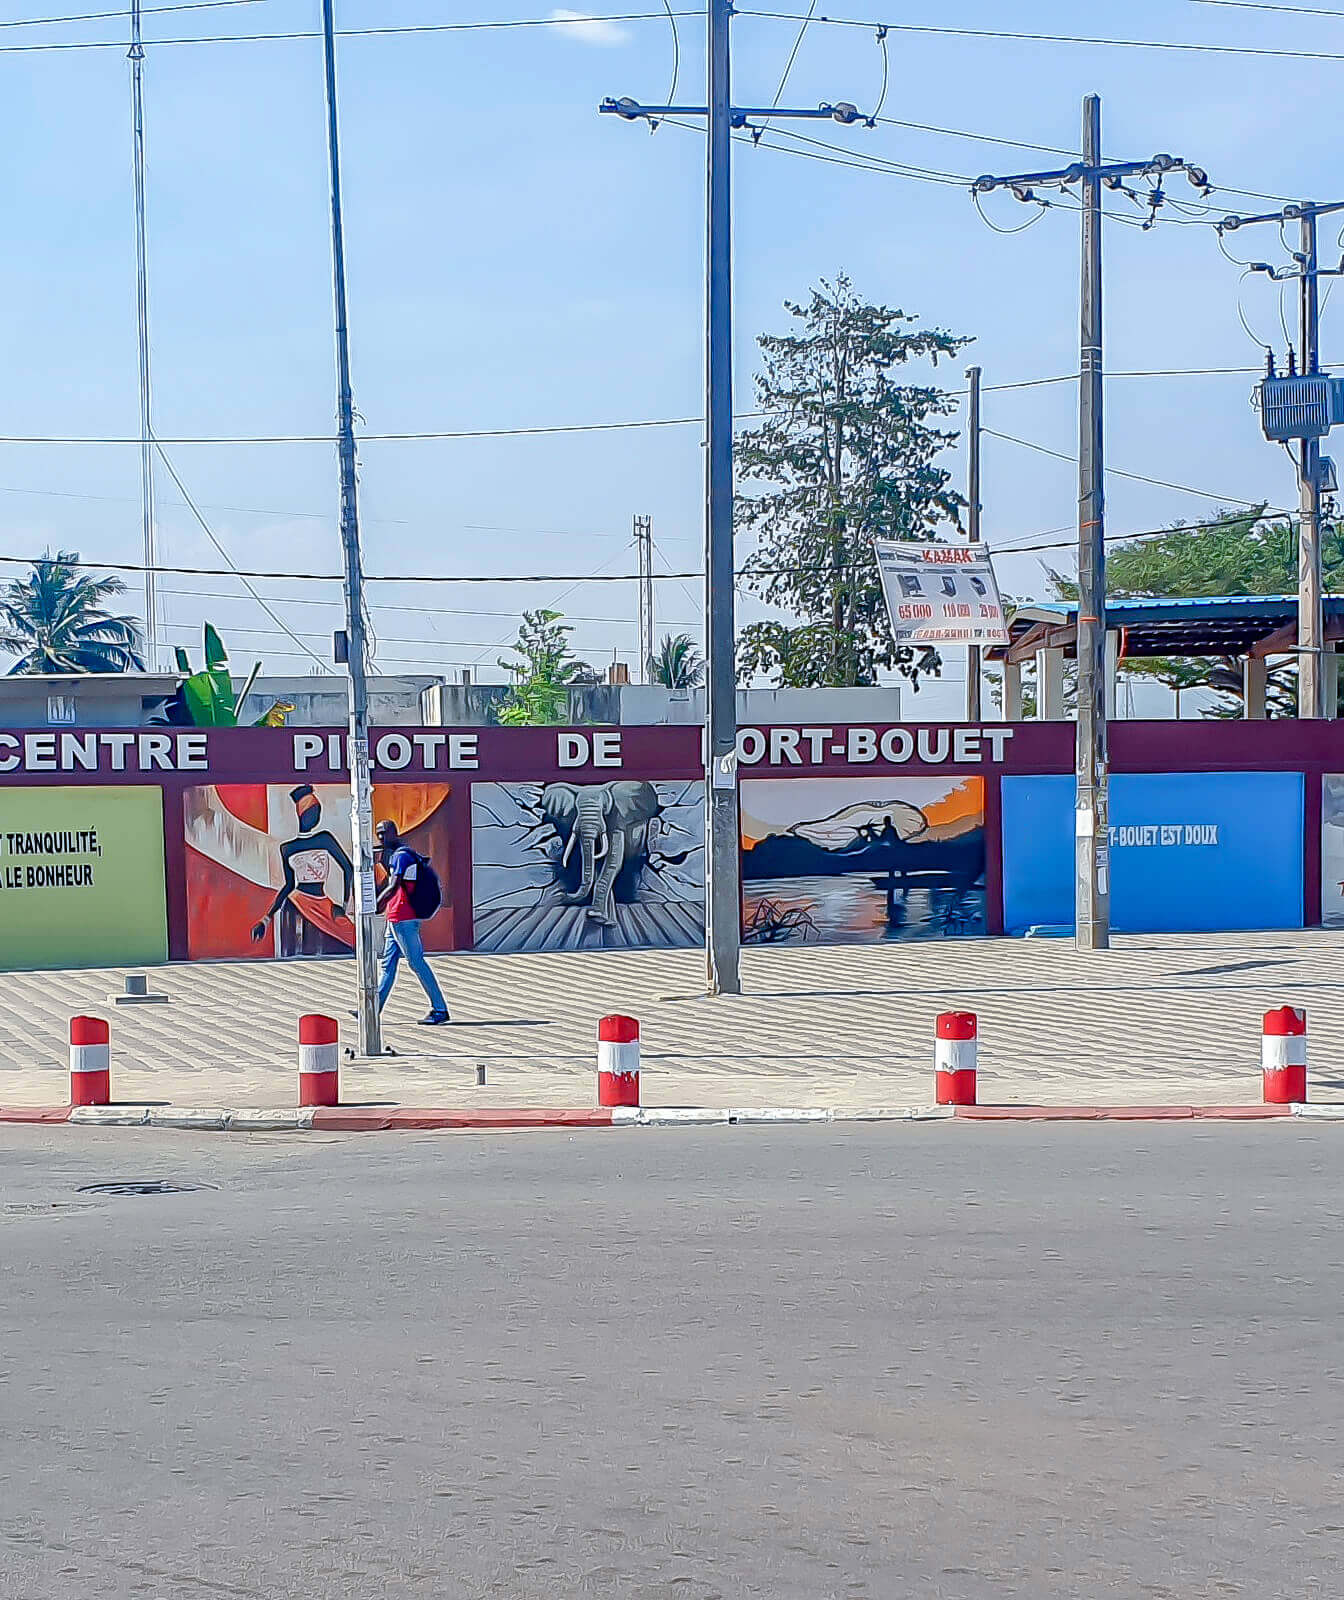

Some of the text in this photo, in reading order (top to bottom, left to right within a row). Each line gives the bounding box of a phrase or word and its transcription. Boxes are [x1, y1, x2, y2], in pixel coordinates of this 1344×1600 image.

[557, 732, 622, 768] DE
[702, 728, 1014, 766] ORT-BOUET
[6, 825, 102, 857] TRANQUILITÉ,
[1160, 825, 1183, 846] EST
[1184, 824, 1218, 845] DOUX
[6, 866, 23, 888] LE
[26, 864, 94, 888] BONHEUR
